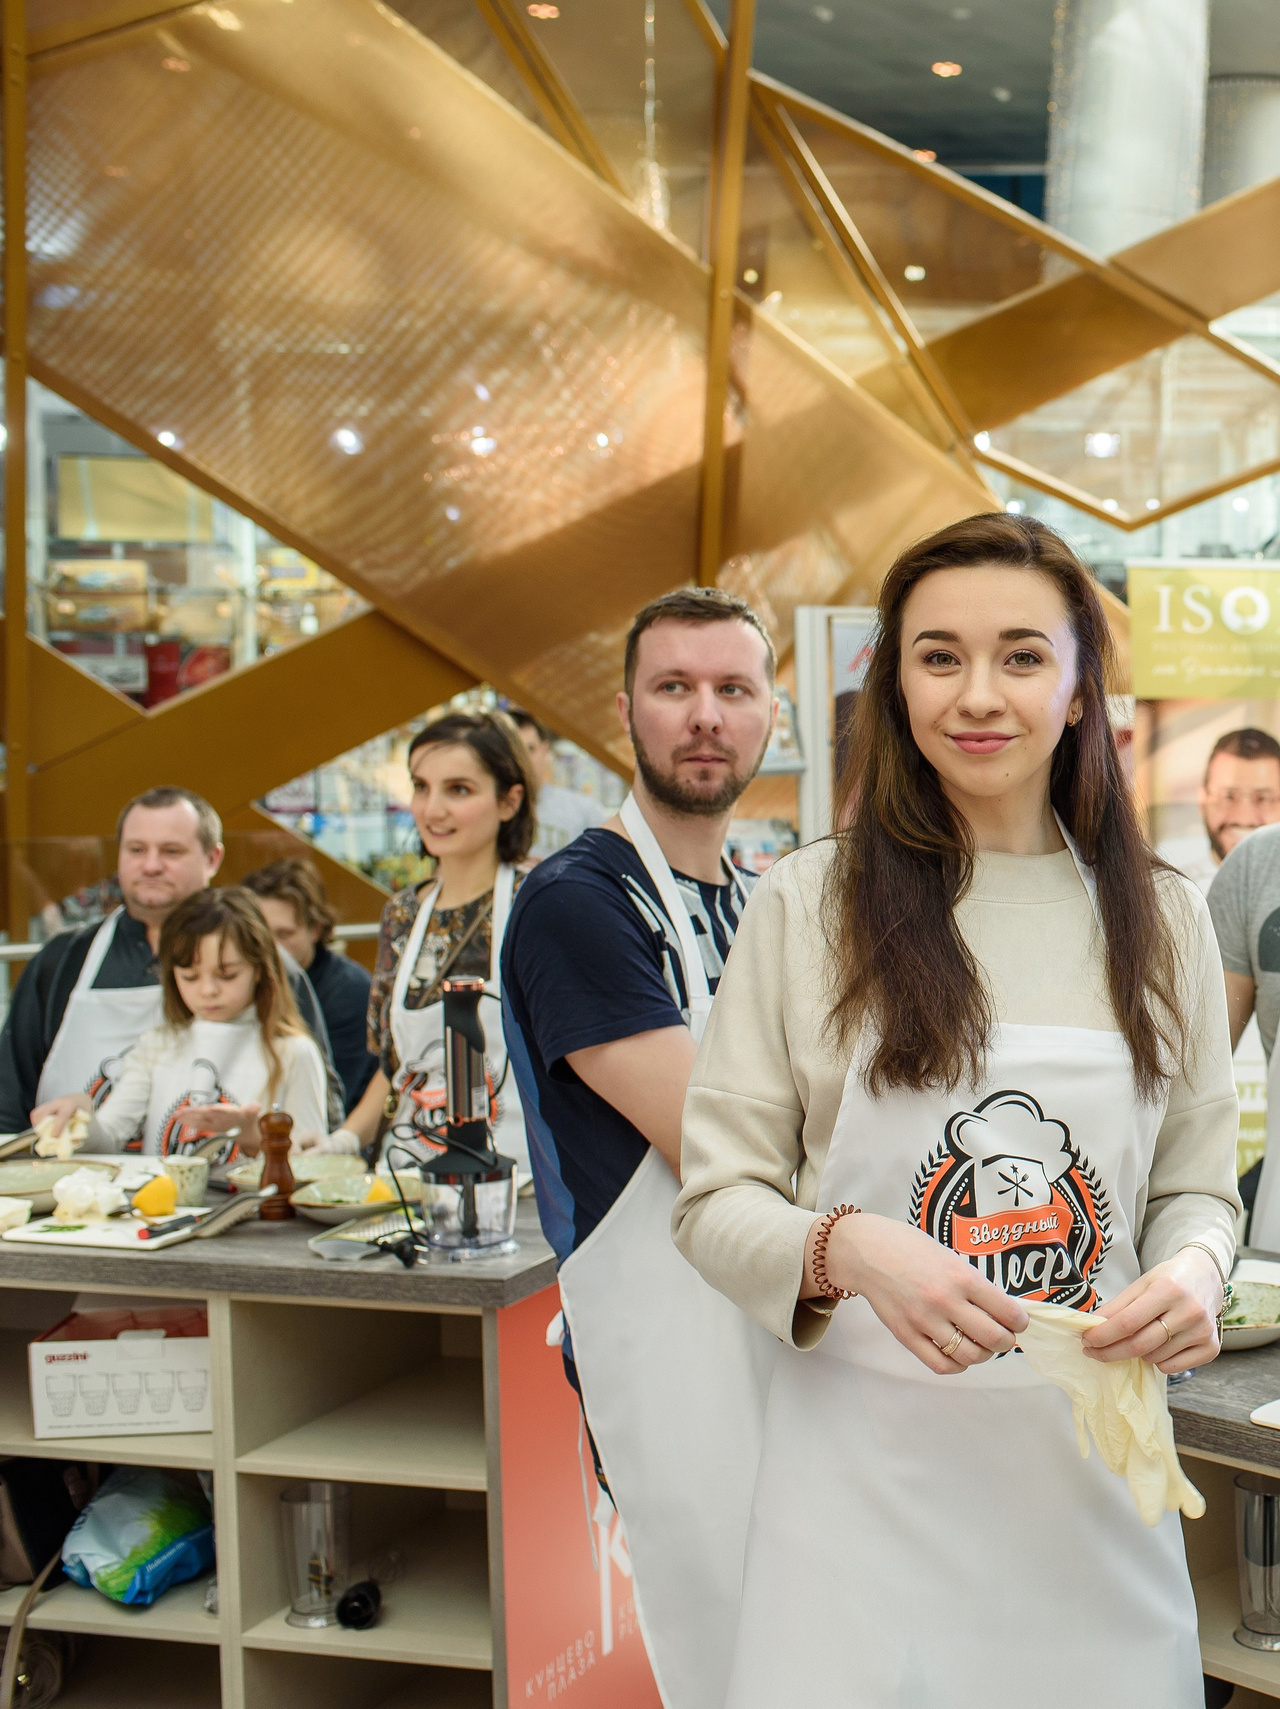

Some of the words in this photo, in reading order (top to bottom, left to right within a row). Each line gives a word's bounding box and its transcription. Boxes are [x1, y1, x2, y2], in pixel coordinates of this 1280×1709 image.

[968, 1212, 1060, 1246] Звездный
[525, 1629, 596, 1698] КУНЦЕВО
[547, 1650, 596, 1702] ПЛАЗА
